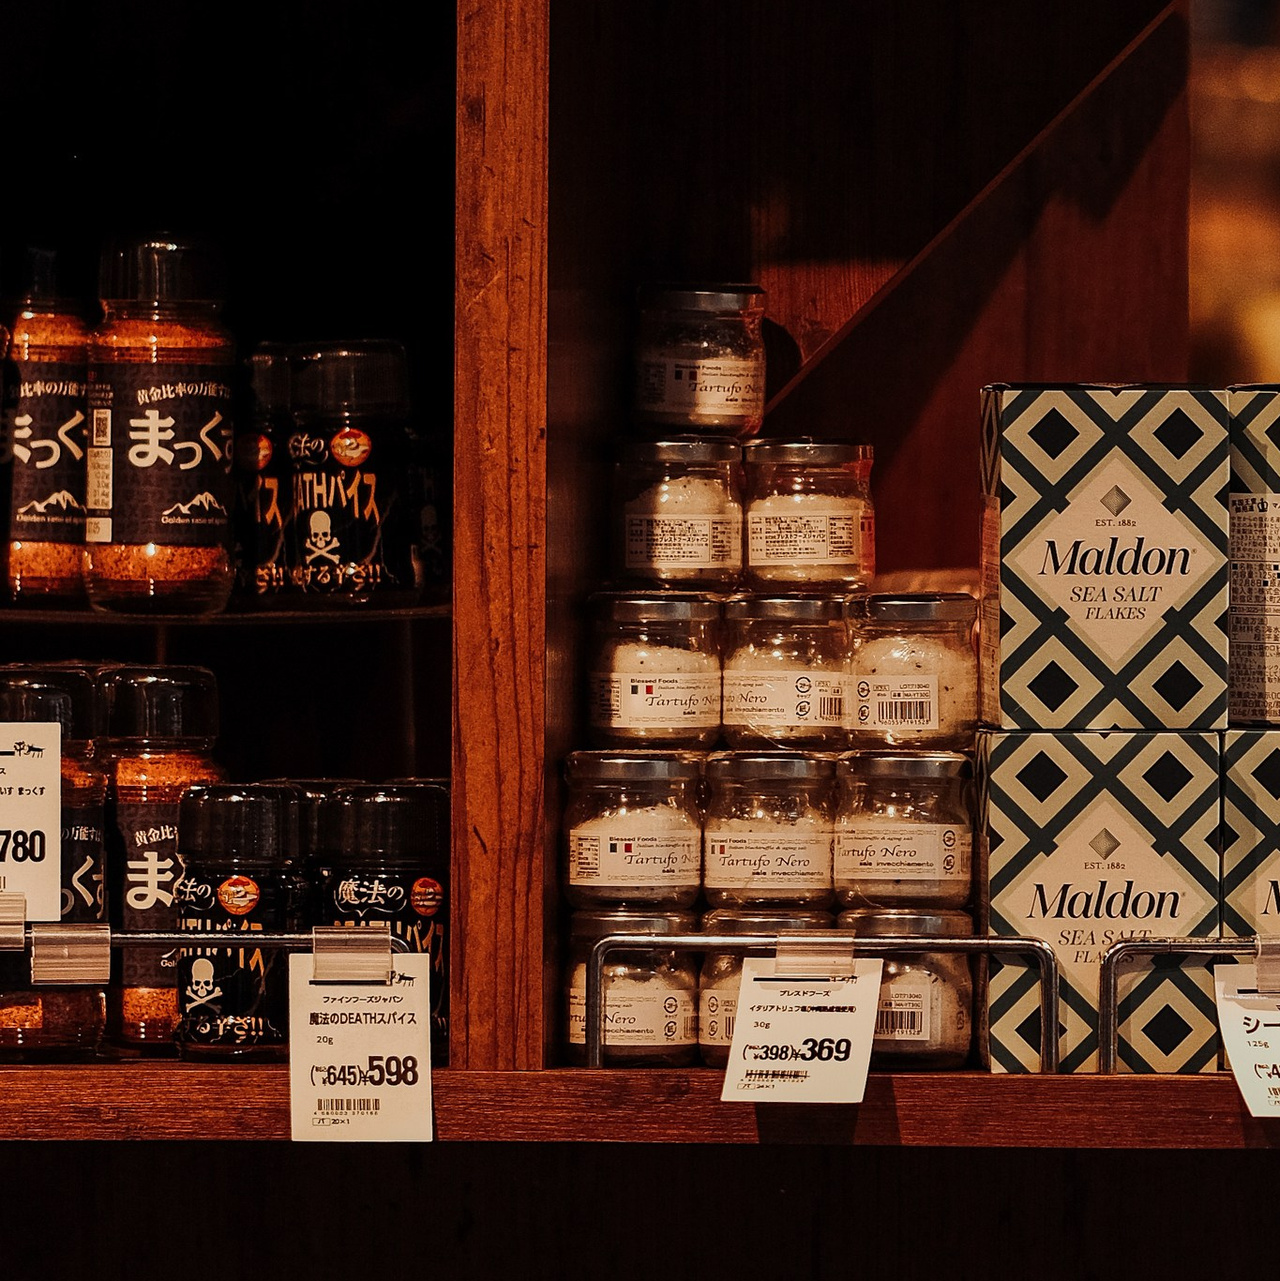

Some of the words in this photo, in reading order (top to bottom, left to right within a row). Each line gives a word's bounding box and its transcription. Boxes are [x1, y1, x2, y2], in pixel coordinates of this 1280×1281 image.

[1095, 519, 1115, 528] EST.
[1118, 519, 1137, 528] 1882
[1037, 537, 1191, 578] Maldon
[1069, 586, 1109, 603] SEA
[1112, 585, 1162, 603] SALT
[1085, 607, 1146, 620] FLAKES
[645, 694, 699, 710] Tartufo
[738, 691, 767, 704] Nero
[18, 786, 46, 796] まっくす
[880, 845, 917, 858] Nero
[624, 852, 678, 868] Tartufo
[719, 854, 771, 871] Tartufo
[776, 854, 811, 867] Nero
[1084, 861, 1103, 870] EST.
[1106, 862, 1126, 870] 1882
[338, 879, 404, 905] 魔法の
[1026, 880, 1180, 920] Maldon
[1058, 930, 1098, 946] SEA
[323, 996, 403, 1004] ファインフーズジャパン
[309, 1012, 417, 1025] 魔法のDEATHスパイス
[754, 1021, 770, 1029] 30g
[316, 1036, 334, 1045] 20g
